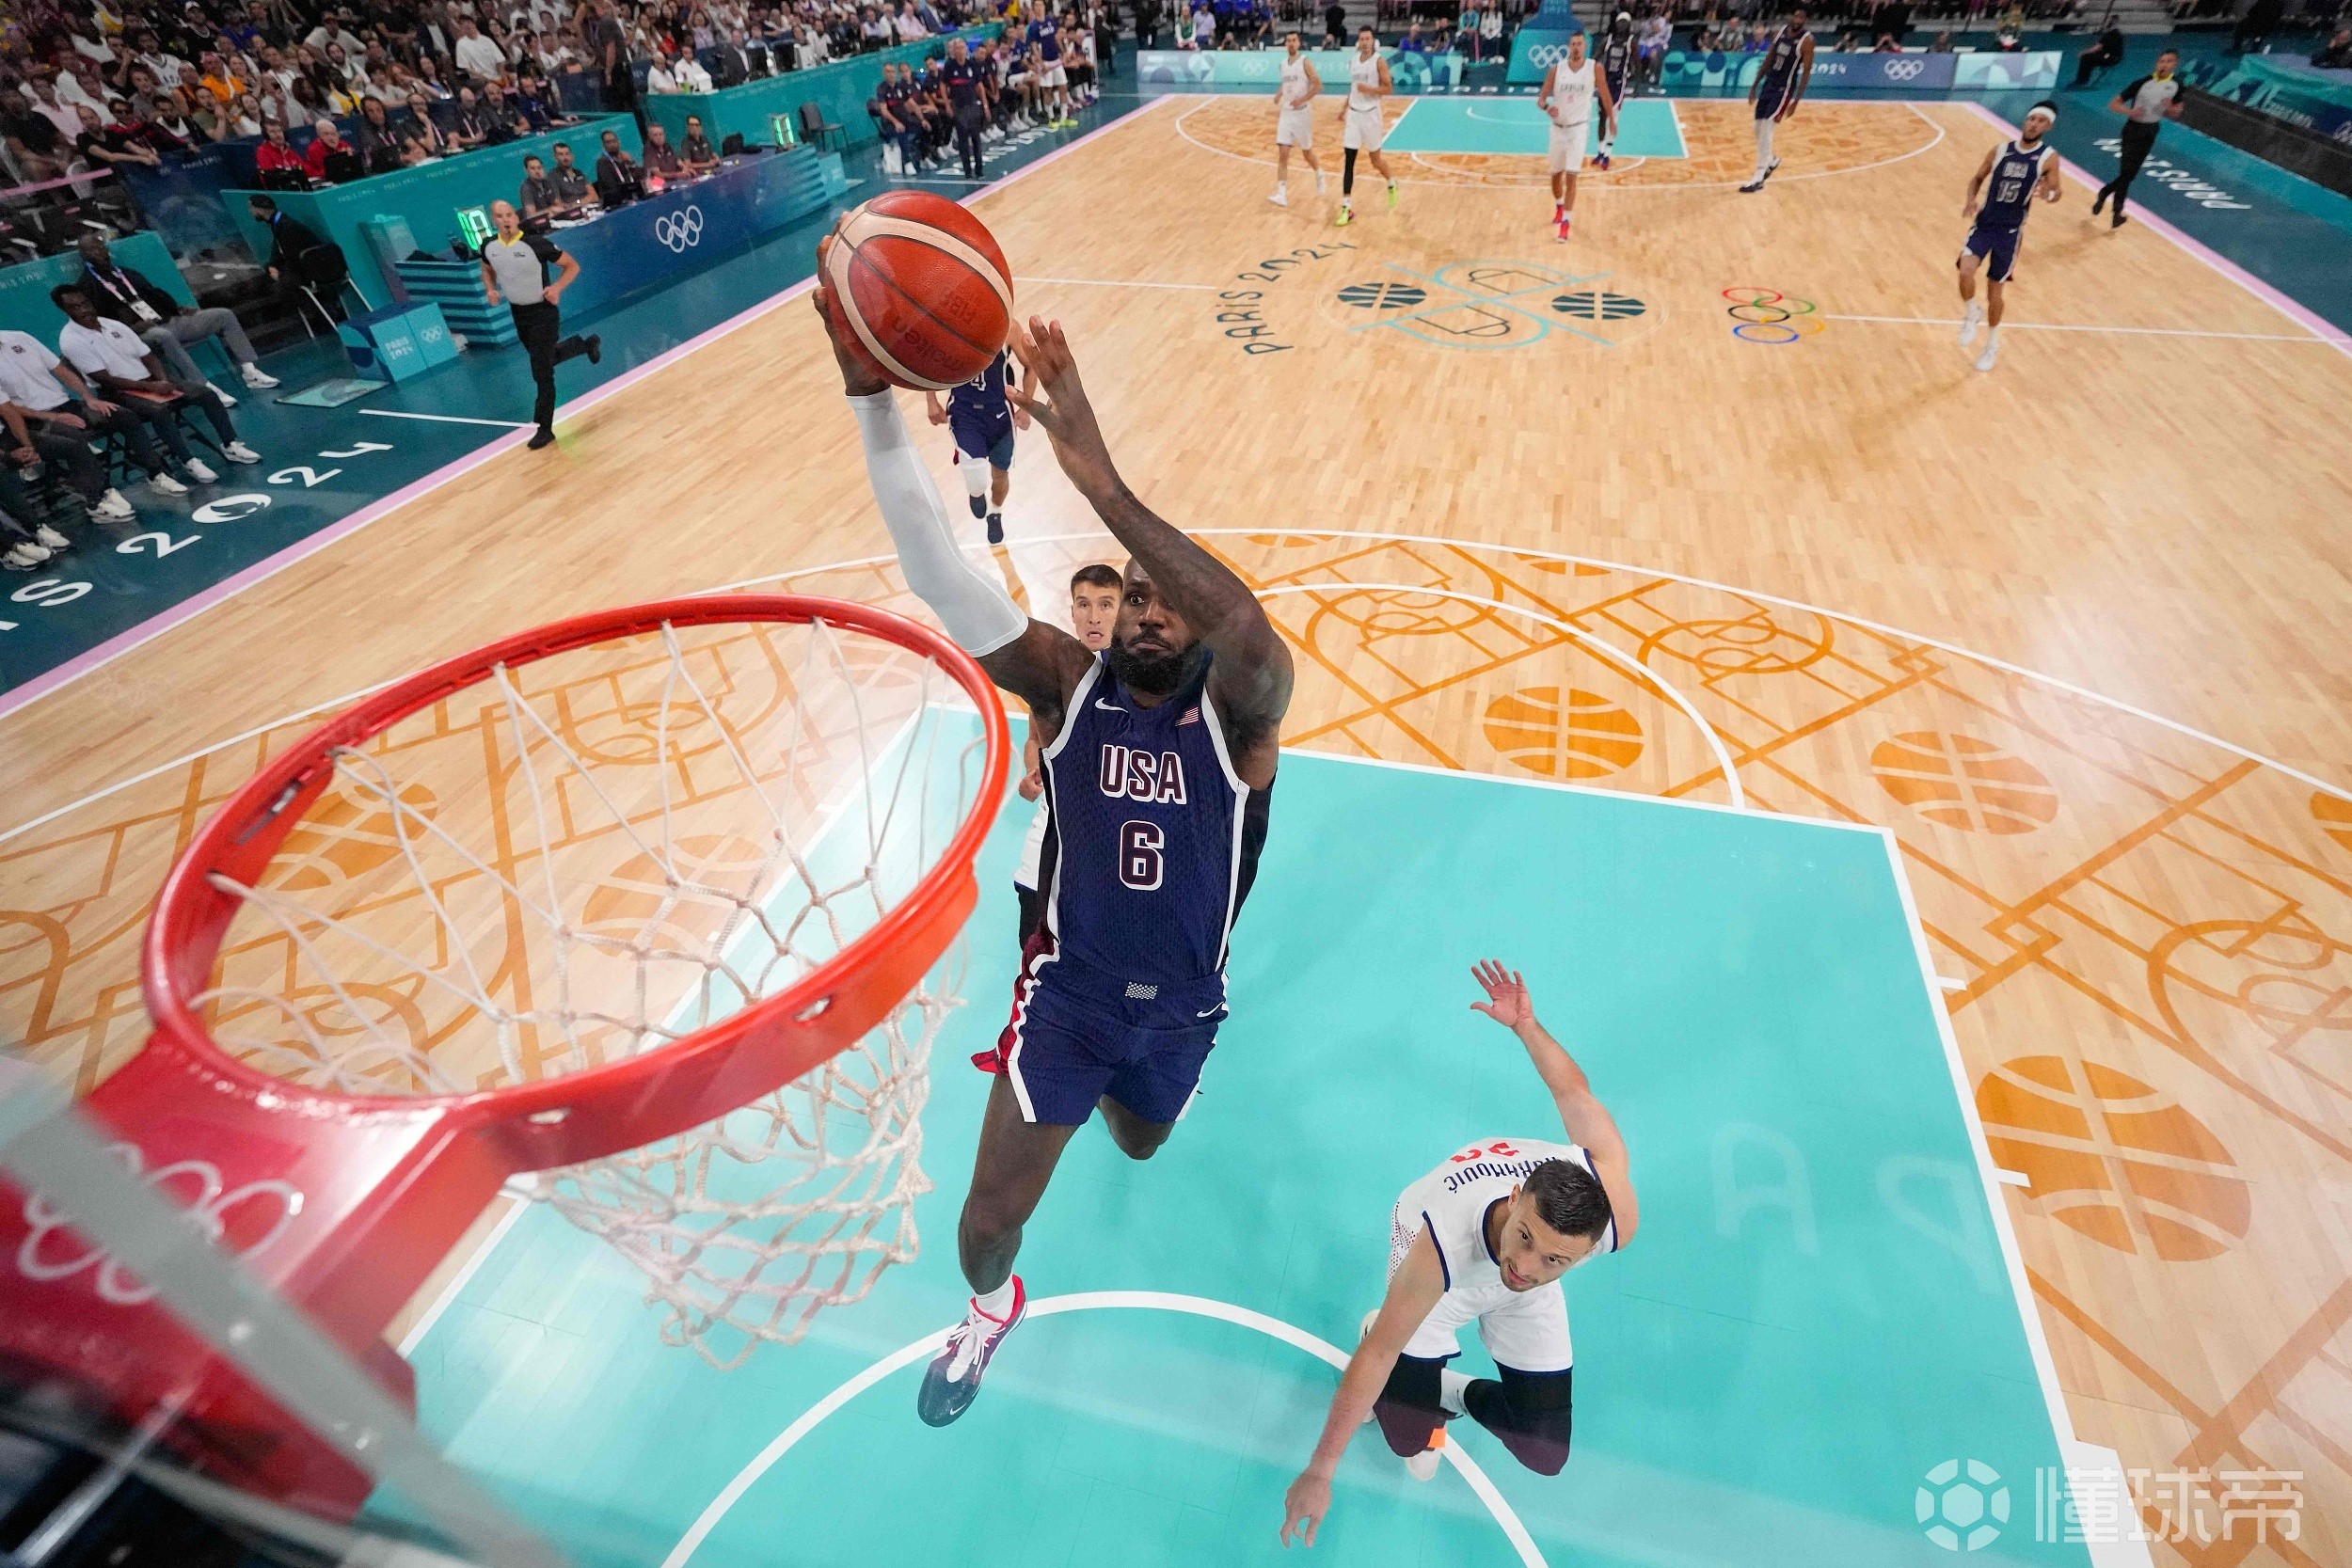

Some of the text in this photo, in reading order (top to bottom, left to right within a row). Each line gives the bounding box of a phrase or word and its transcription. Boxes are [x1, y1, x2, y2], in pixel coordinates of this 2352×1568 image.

[1237, 242, 1358, 282] 2024
[116, 441, 394, 559] 2024
[1100, 744, 1187, 805] USA
[1120, 820, 1164, 891] 6
